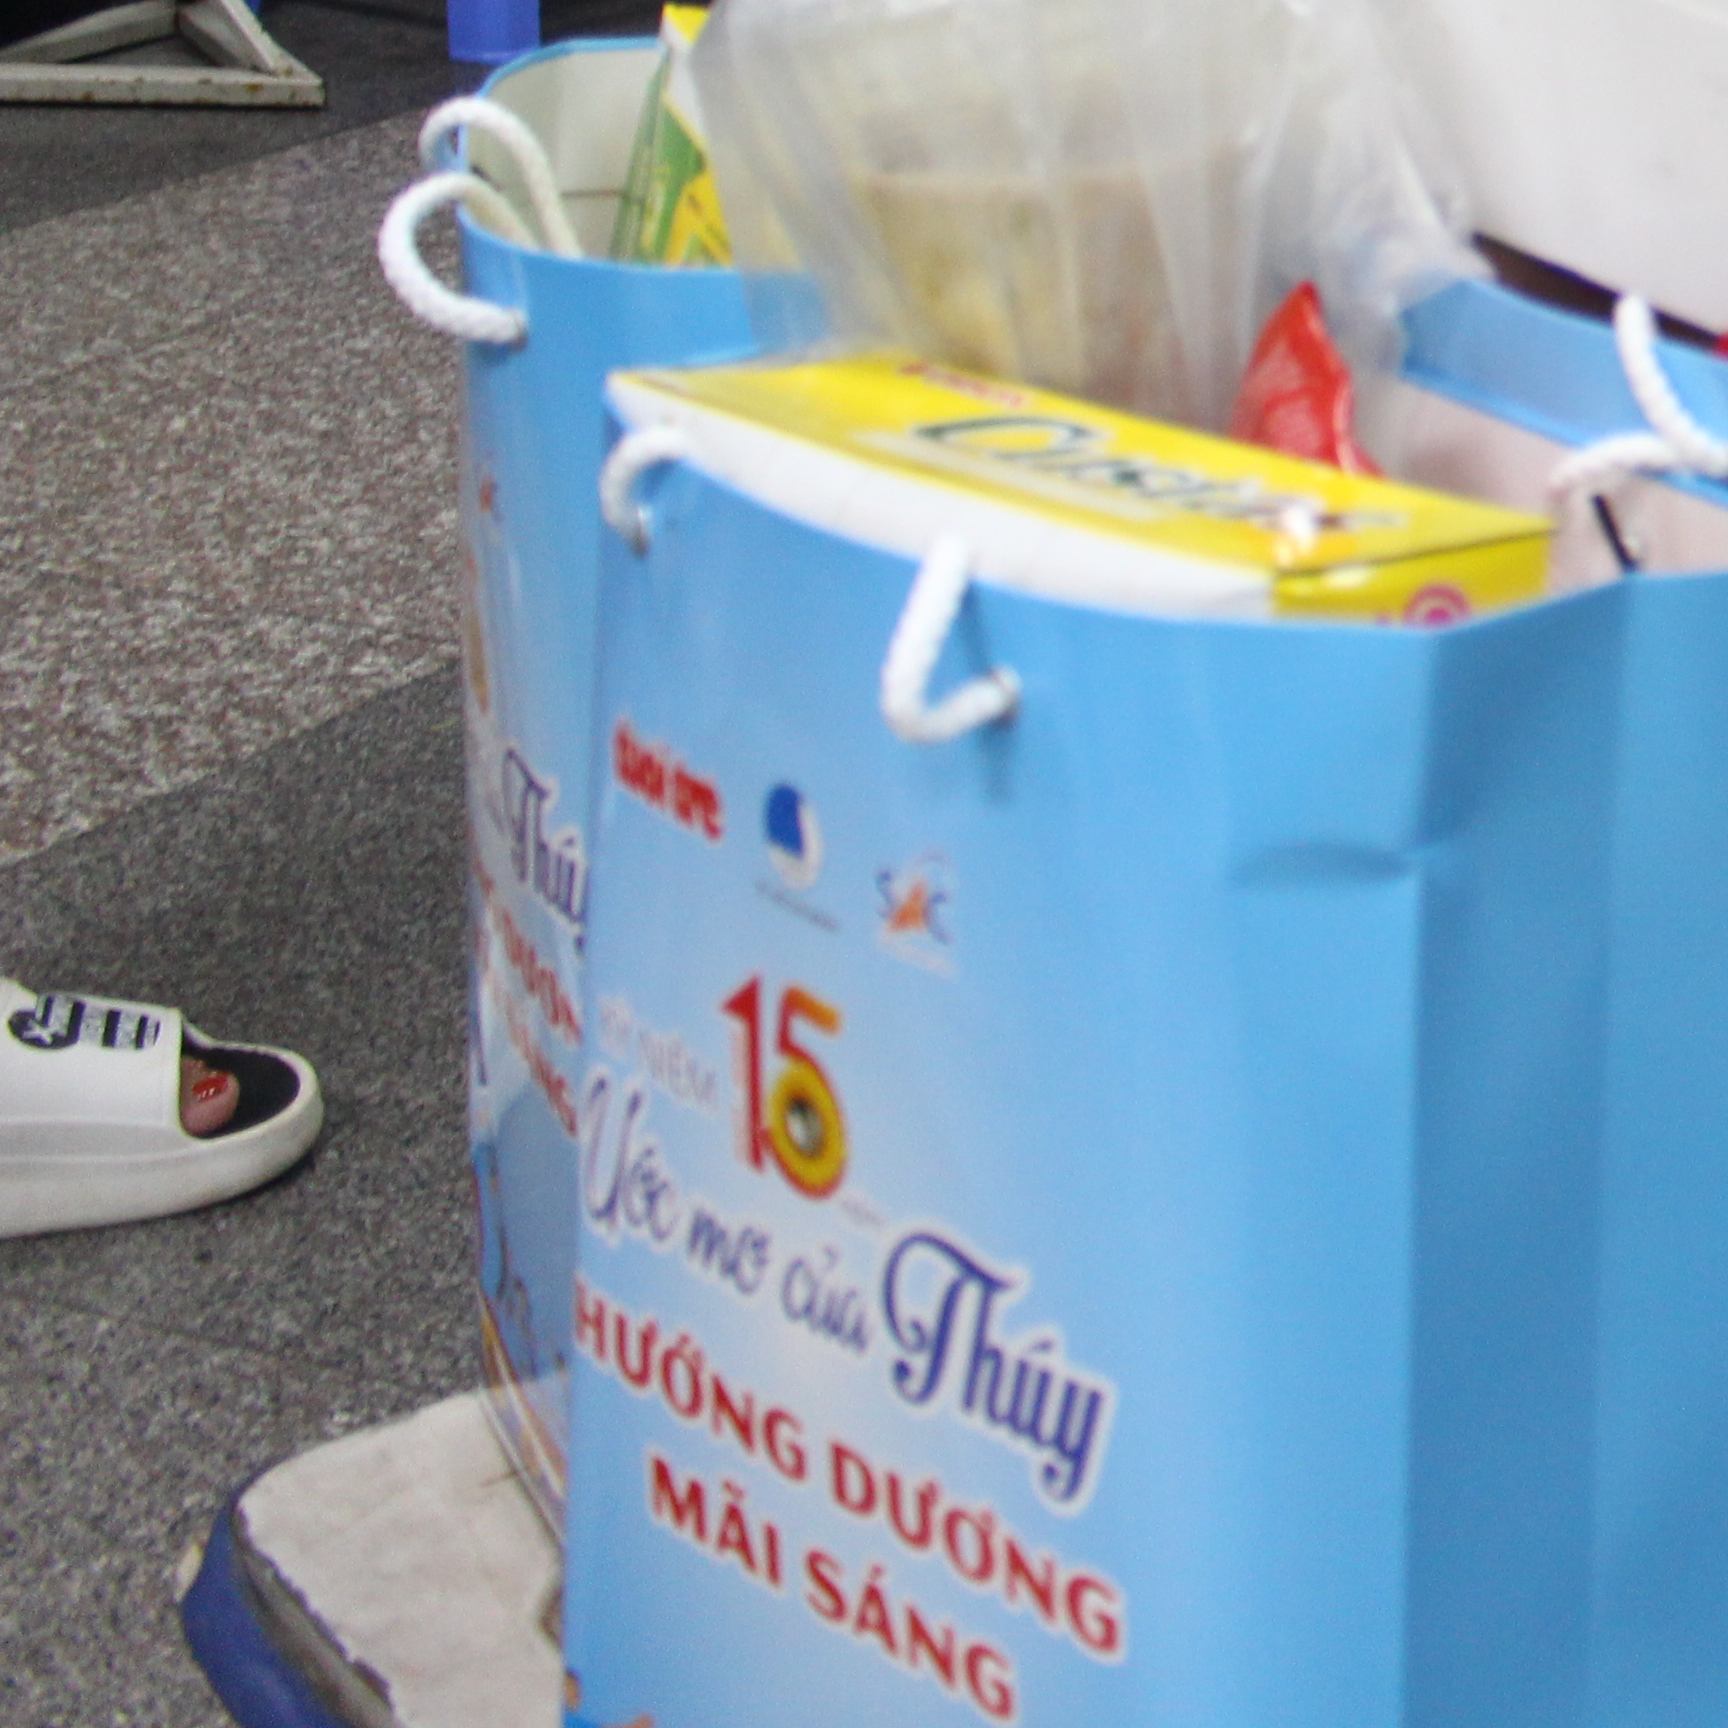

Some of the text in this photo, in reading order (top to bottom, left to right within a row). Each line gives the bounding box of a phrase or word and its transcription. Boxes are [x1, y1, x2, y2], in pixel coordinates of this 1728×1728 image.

[720, 974, 849, 1200] 15
[573, 1280, 1120, 1653] HƯỚNG DƯƠNG
[881, 1232, 1102, 1502] Thúy
[650, 1455, 1015, 1720] MÃI SÁNG
